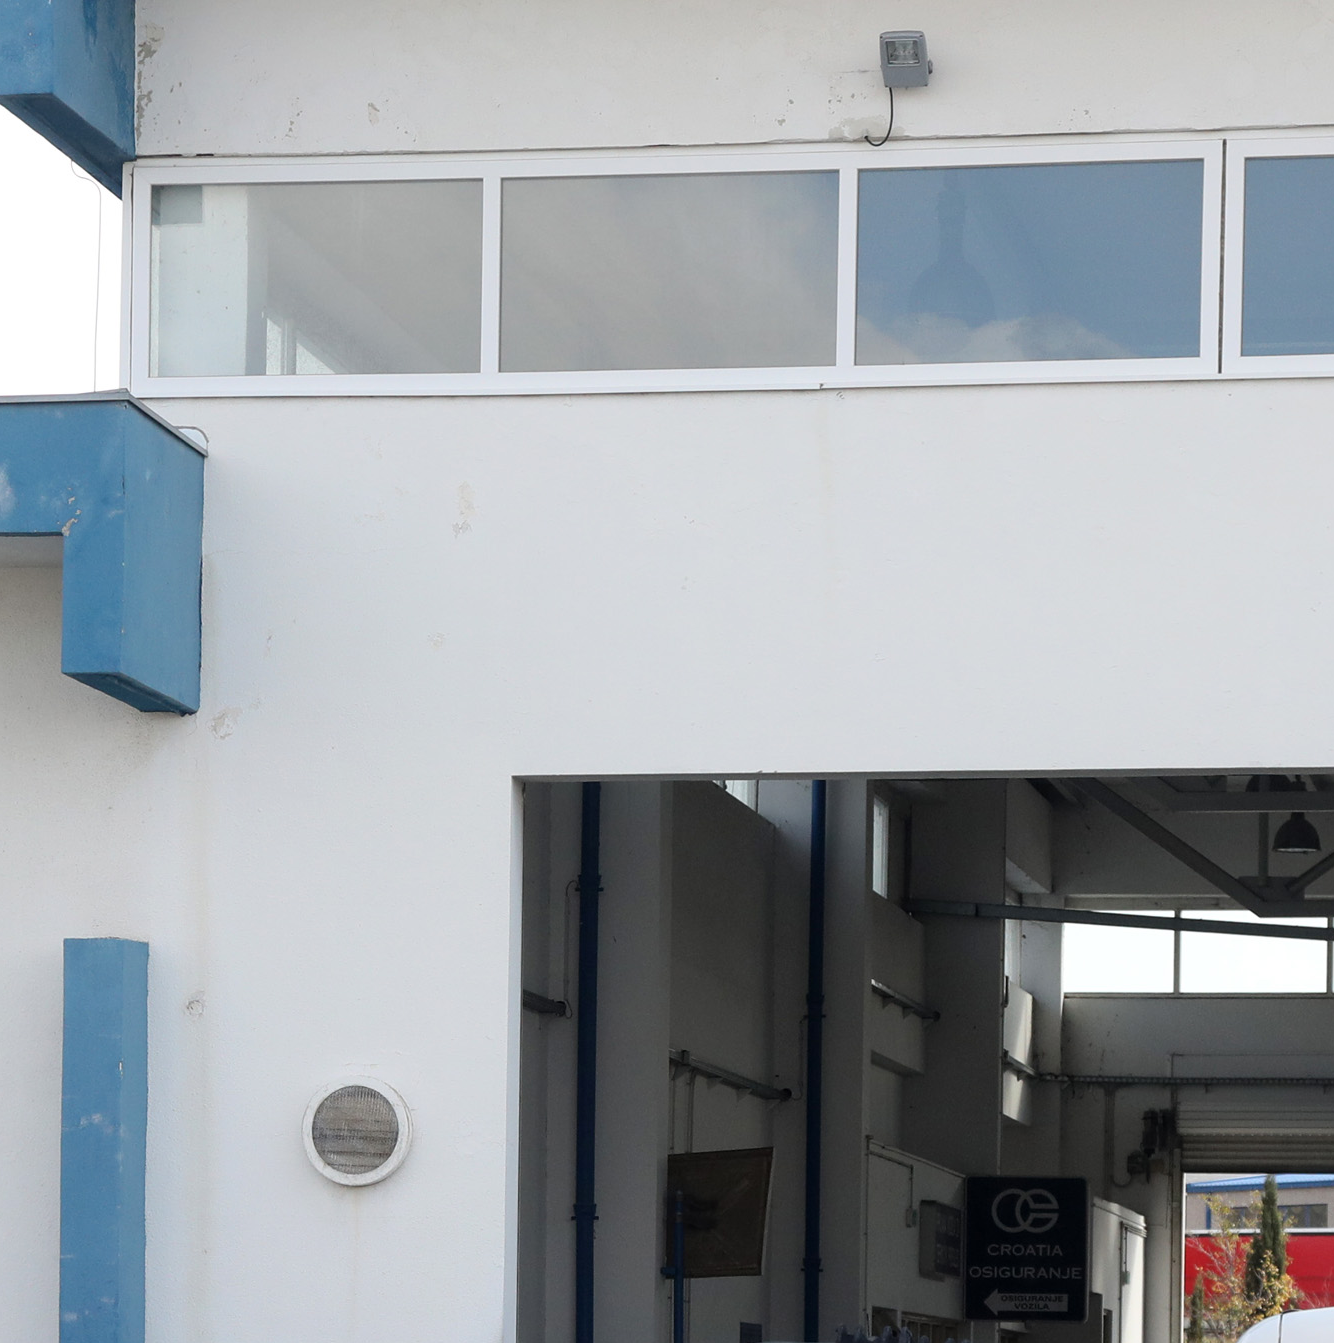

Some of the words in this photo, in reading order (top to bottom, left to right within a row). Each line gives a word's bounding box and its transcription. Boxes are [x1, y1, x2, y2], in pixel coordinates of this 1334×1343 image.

[987, 1243, 1064, 1256] CROATIA
[969, 1266, 1083, 1279] OSIGURANJE
[1001, 1294, 1065, 1303] OSIGURANJE
[1013, 1302, 1051, 1311] VOZILA
